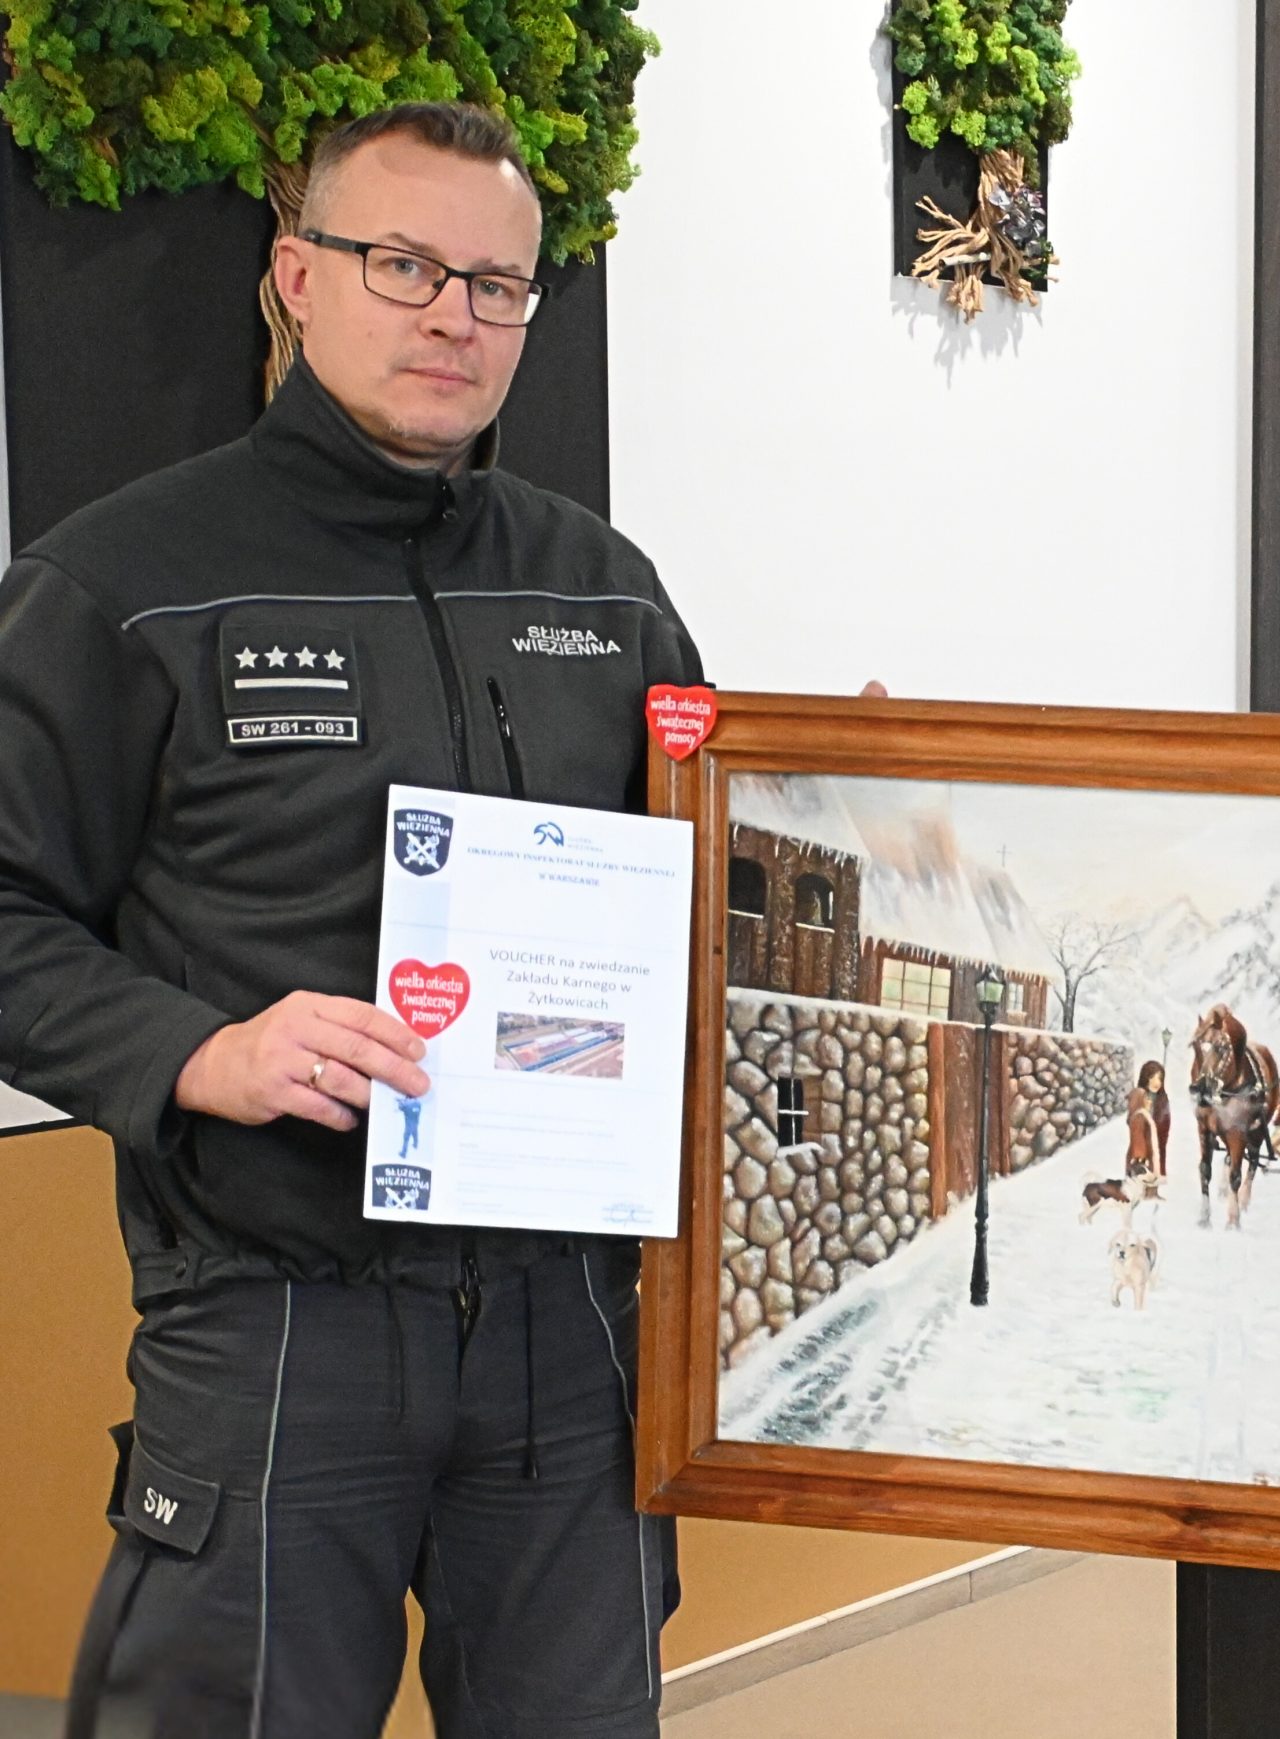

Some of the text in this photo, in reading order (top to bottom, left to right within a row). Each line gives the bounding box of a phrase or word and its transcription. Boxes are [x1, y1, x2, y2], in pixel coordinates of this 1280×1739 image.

[241, 723, 266, 738] SW
[270, 721, 299, 735] 261
[314, 721, 345, 735] 093
[489, 948, 651, 976] VOUCHER na zwiedzanie
[506, 969, 632, 993] Zakładu Karnego w
[143, 1486, 179, 1525] SW
